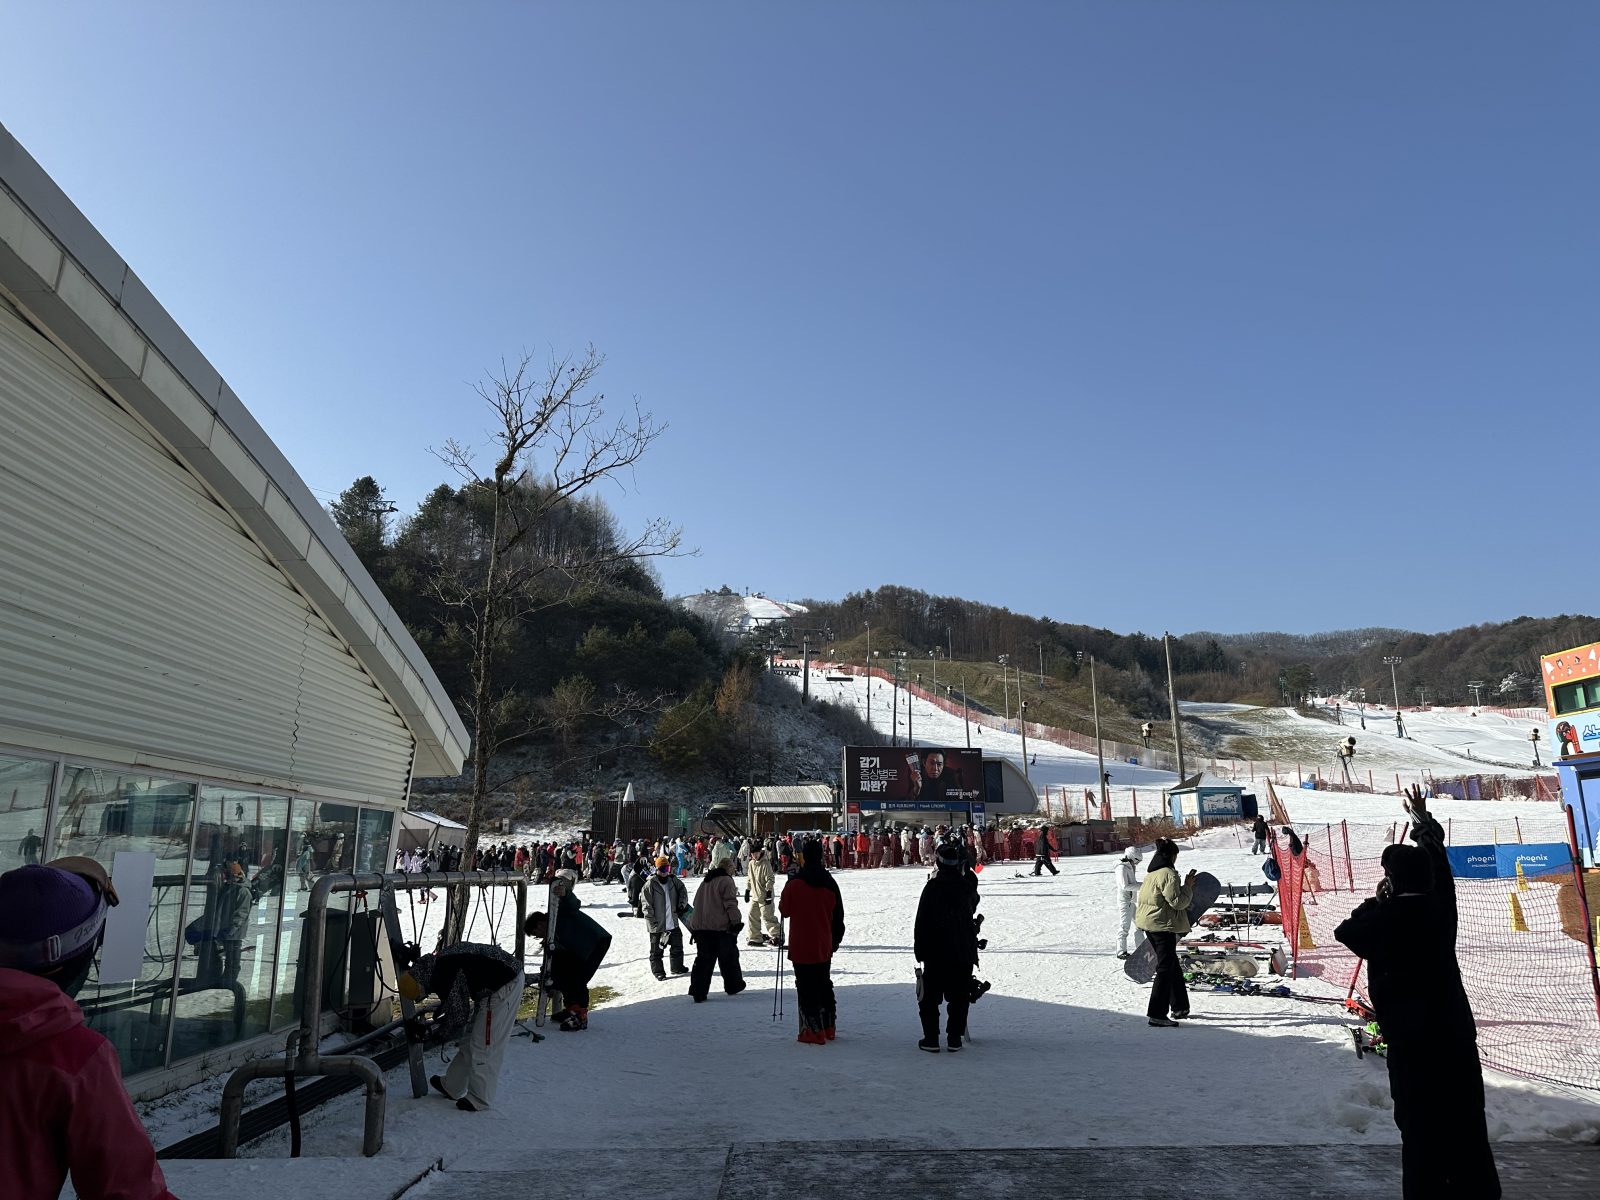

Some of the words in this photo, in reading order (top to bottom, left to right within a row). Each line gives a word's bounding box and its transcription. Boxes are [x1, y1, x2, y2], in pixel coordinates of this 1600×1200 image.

[859, 756, 880, 768] 감기
[860, 768, 898, 780] 증상별로
[1467, 854, 1495, 863] phoeni
[1516, 854, 1549, 863] phoenix
